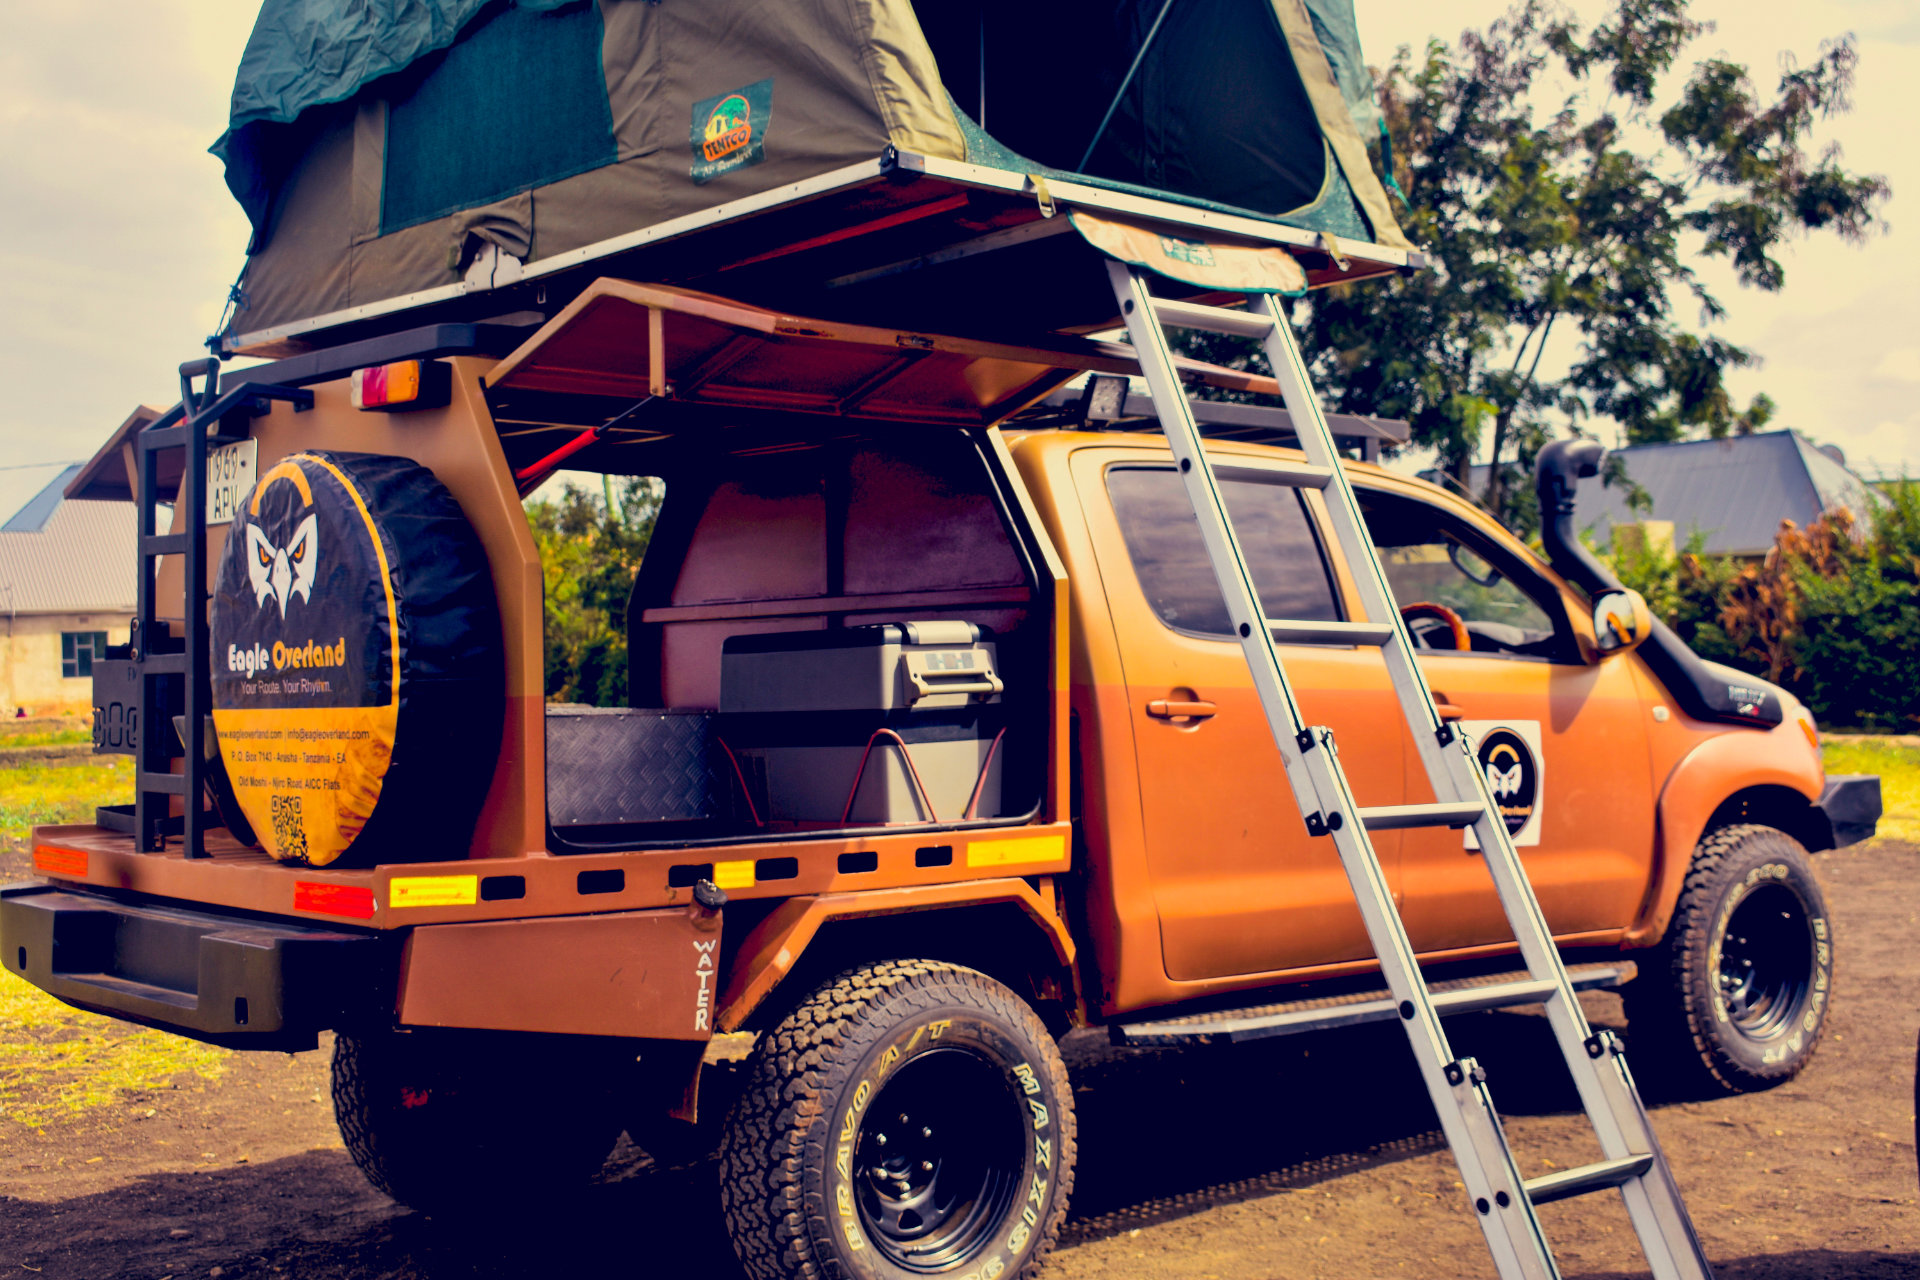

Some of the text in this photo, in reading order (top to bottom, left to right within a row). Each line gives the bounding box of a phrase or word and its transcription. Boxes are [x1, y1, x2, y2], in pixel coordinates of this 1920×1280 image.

[705, 130, 747, 157] TENTCO
[214, 485, 240, 518] APV
[228, 637, 345, 679] Eagle Overland
[241, 681, 257, 694] Your
[258, 680, 281, 694] Route.
[282, 680, 300, 694] Your
[245, 751, 257, 762] Box
[277, 752, 298, 763] Arusha
[302, 752, 330, 764] Tanzania
[337, 752, 346, 764] EA
[239, 776, 249, 787] Old
[305, 778, 321, 790] AICC
[324, 778, 341, 790] Flats
[693, 939, 717, 1031] WATER
[1803, 918, 1830, 1033] BRAVO
[836, 1020, 951, 1251] BRAVO A/T
[1007, 1063, 1051, 1255] MAXXIS
